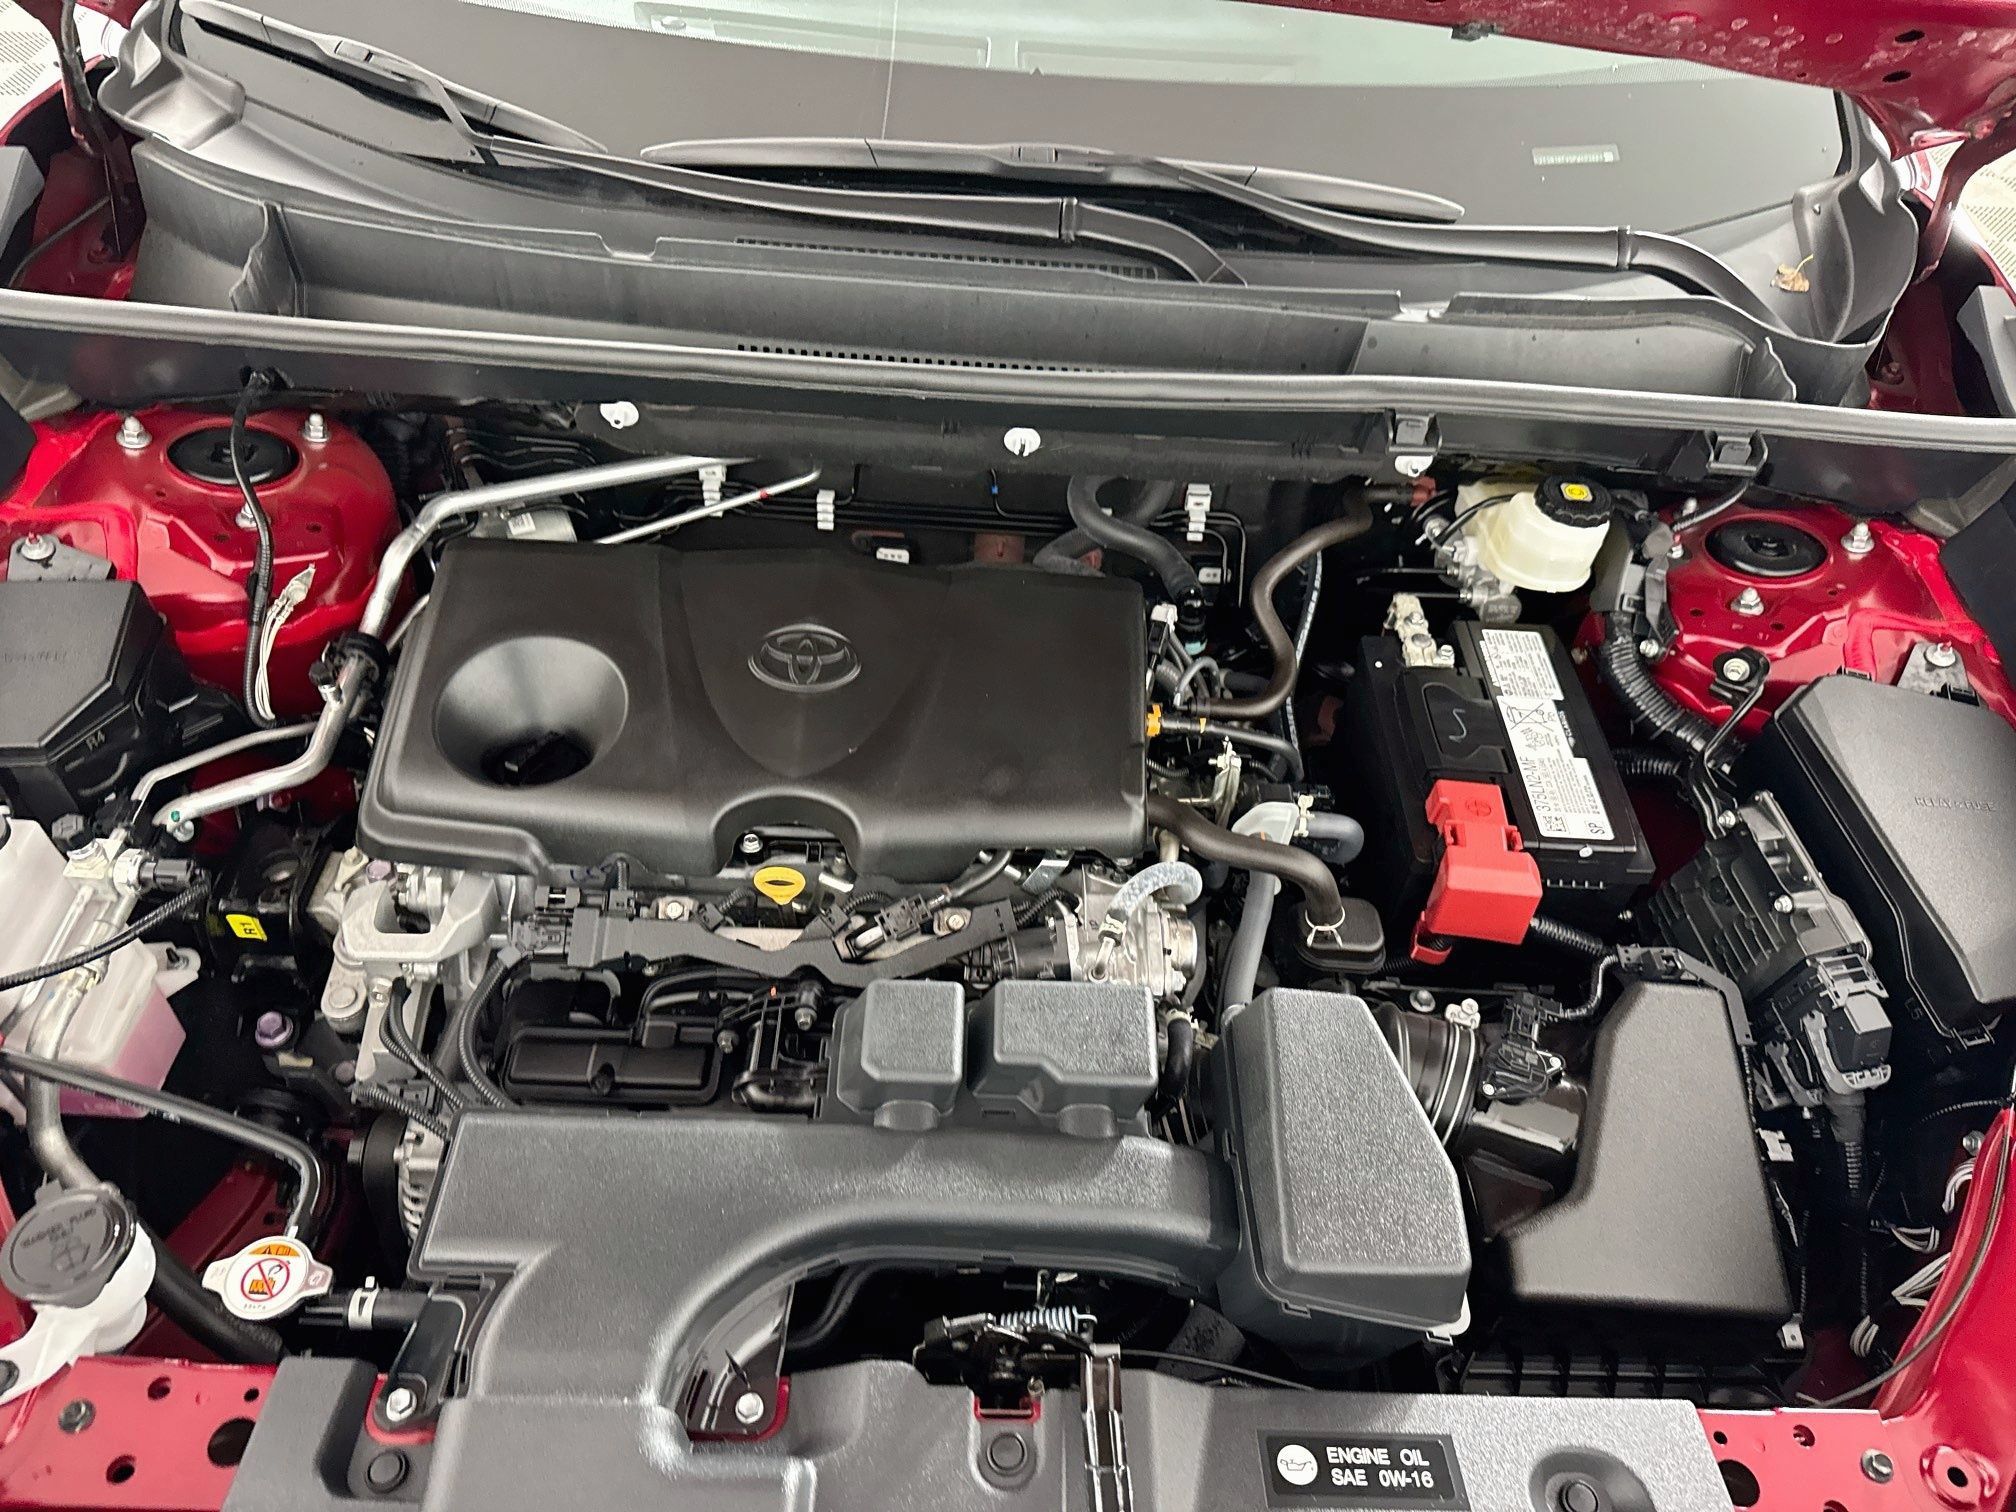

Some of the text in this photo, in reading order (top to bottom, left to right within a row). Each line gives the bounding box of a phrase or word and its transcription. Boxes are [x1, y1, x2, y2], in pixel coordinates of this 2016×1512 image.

[1588, 822, 1606, 836] SP
[1326, 1447, 1430, 1467] ENGINE OIL
[1331, 1468, 1434, 1489] SAE 0W-16
